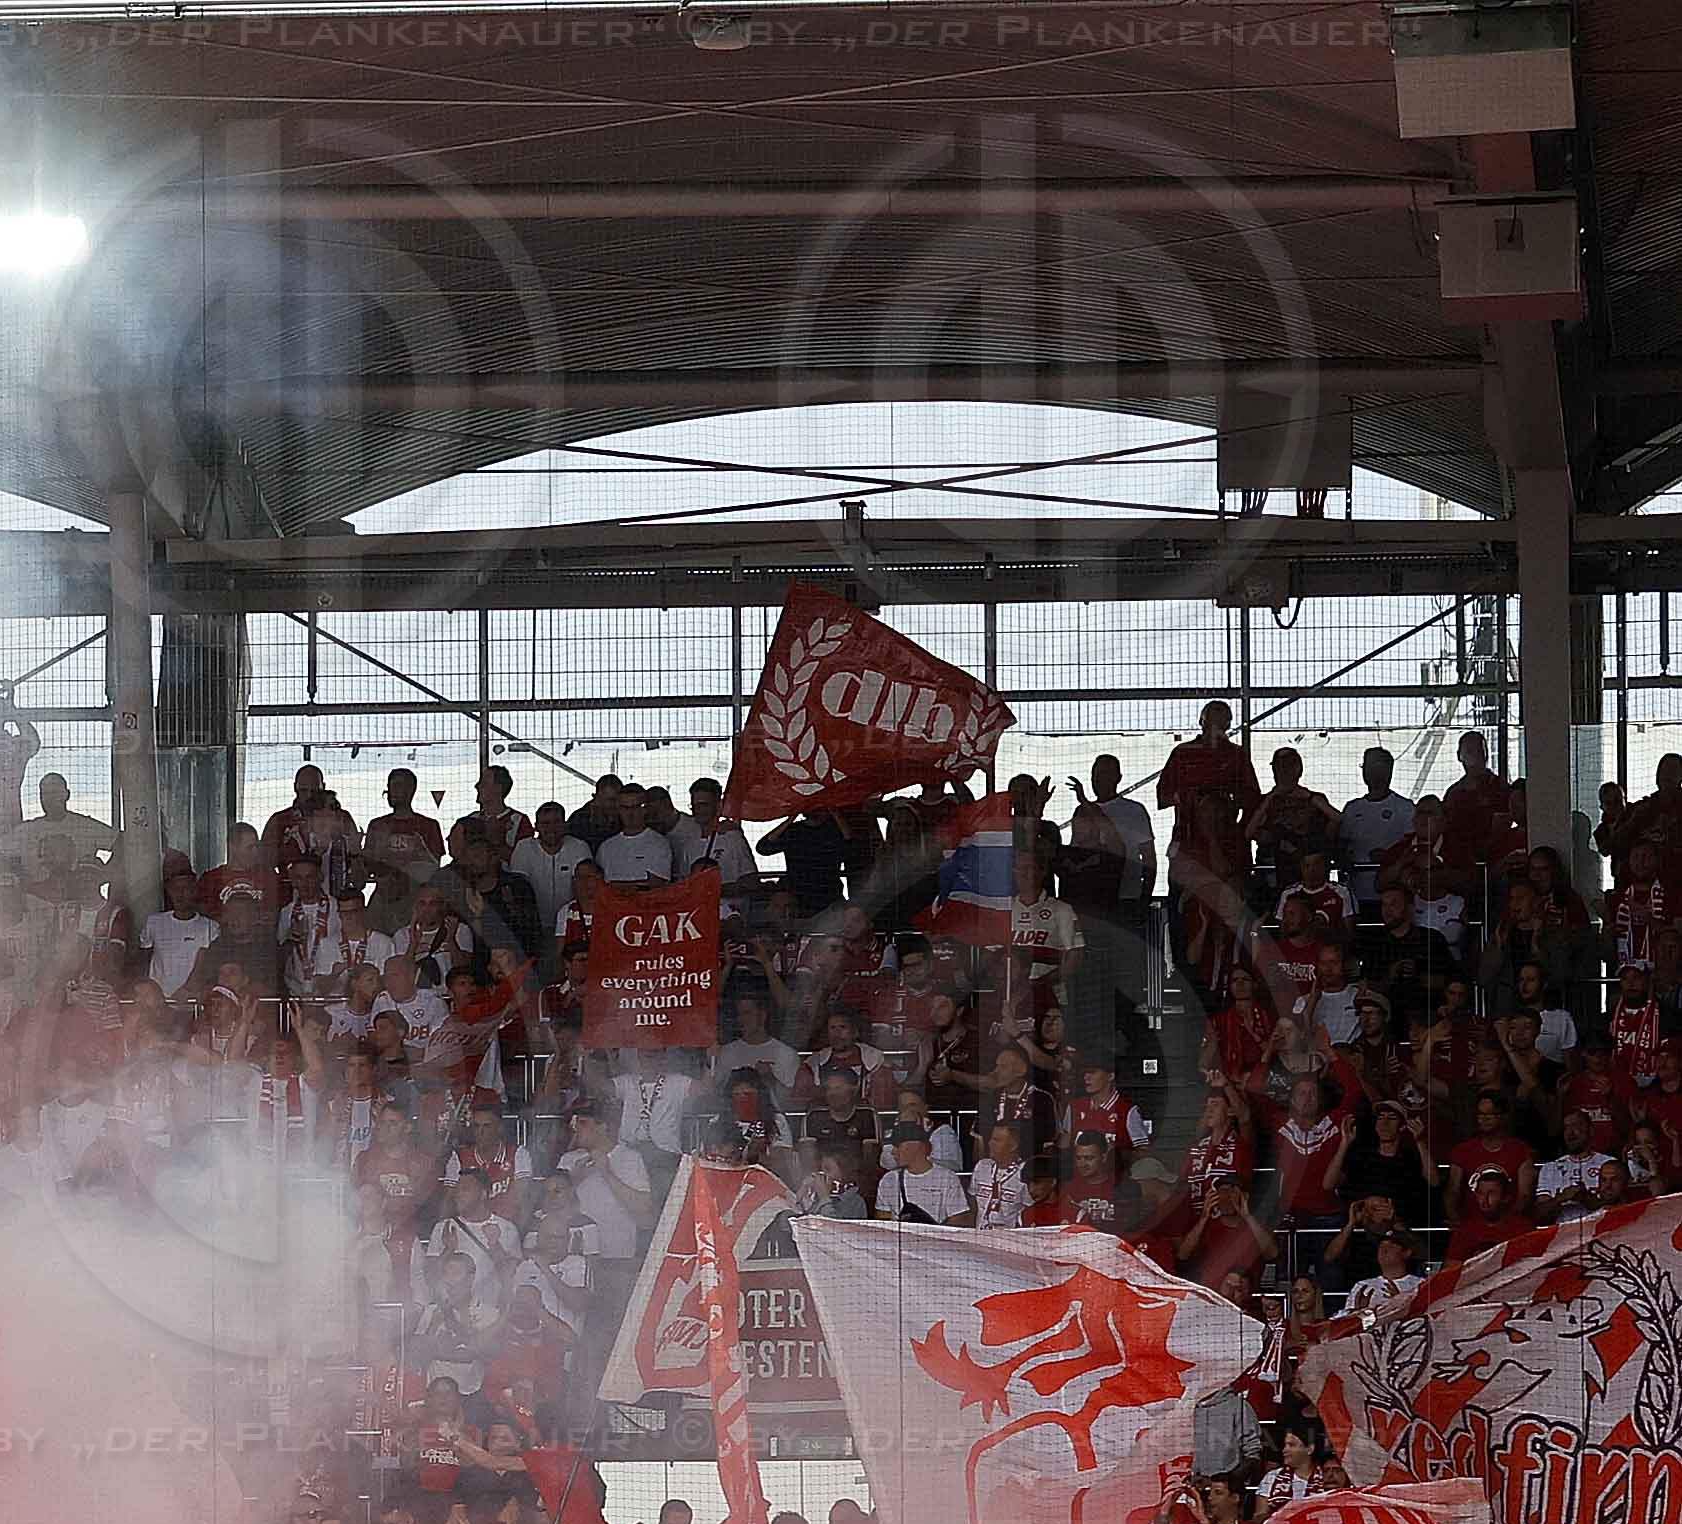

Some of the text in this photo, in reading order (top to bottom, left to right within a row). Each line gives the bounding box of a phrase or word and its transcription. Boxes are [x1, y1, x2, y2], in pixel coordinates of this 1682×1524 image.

[614, 907, 704, 947] GAK
[634, 953, 685, 971] rules
[600, 968, 712, 995] everything
[619, 989, 692, 1009] around
[635, 1011, 672, 1027] me.
